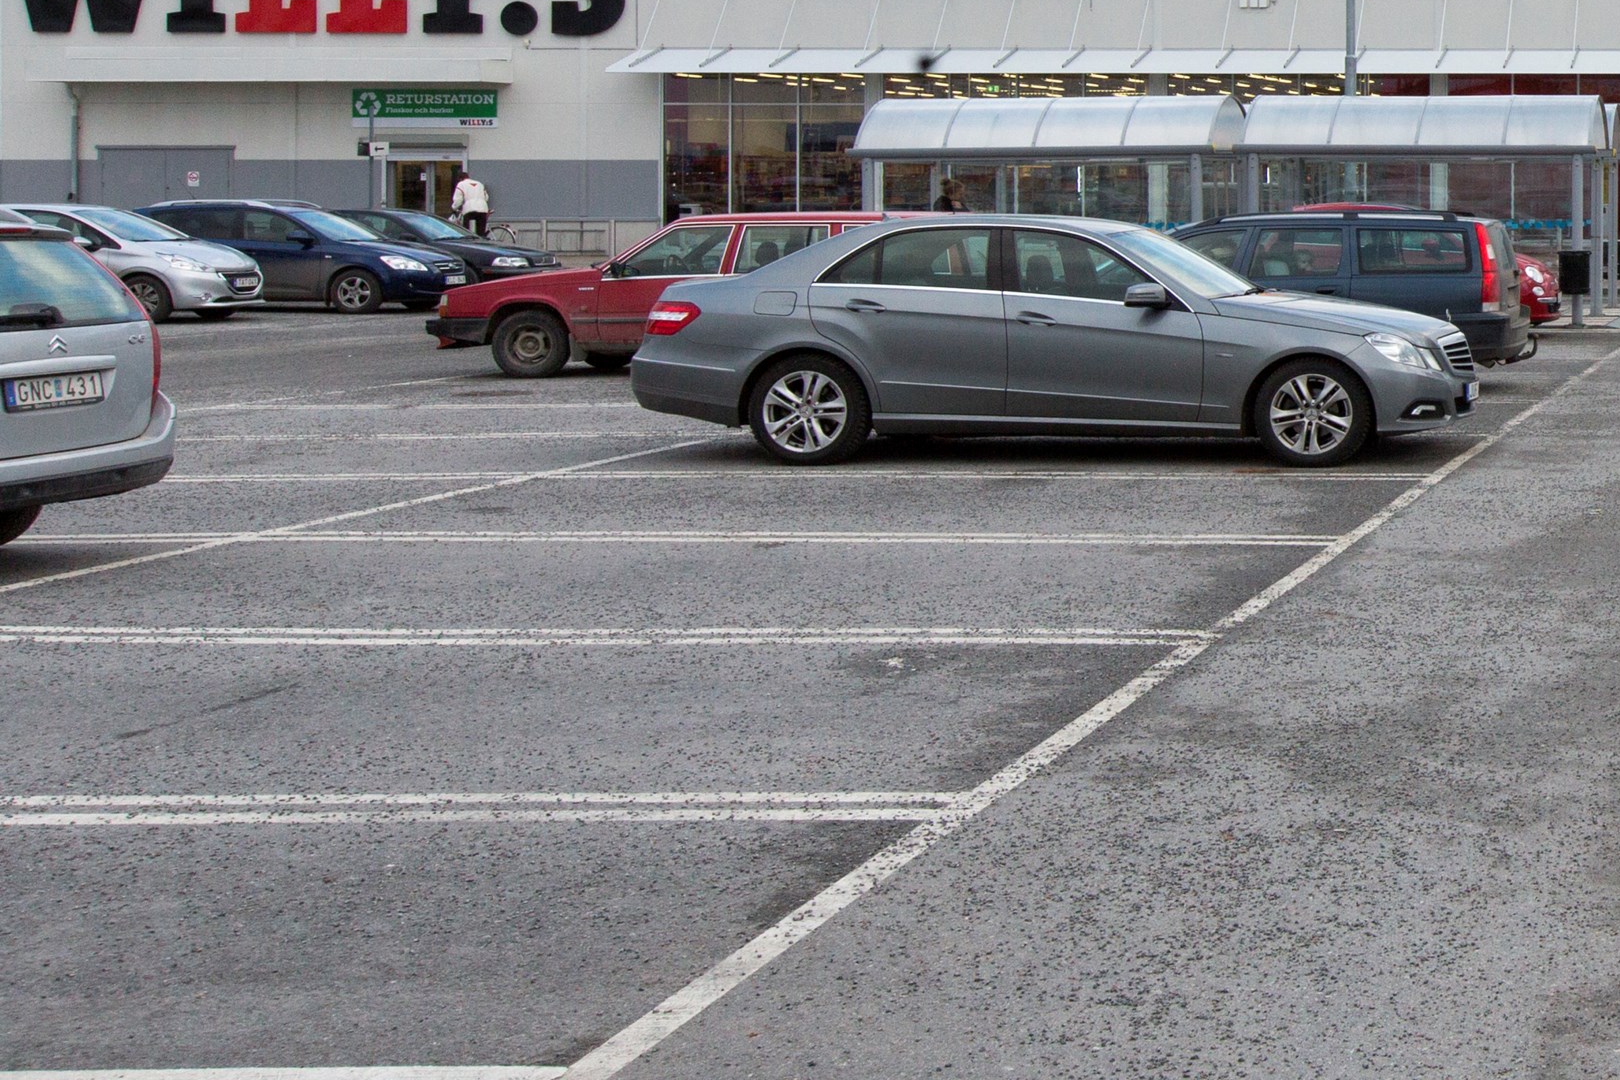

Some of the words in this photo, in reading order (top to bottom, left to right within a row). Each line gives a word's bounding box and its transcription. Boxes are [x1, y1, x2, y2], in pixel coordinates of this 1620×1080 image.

[385, 94, 494, 105] RETURSTATION
[18, 380, 53, 402] GNC
[66, 375, 97, 397] 431
